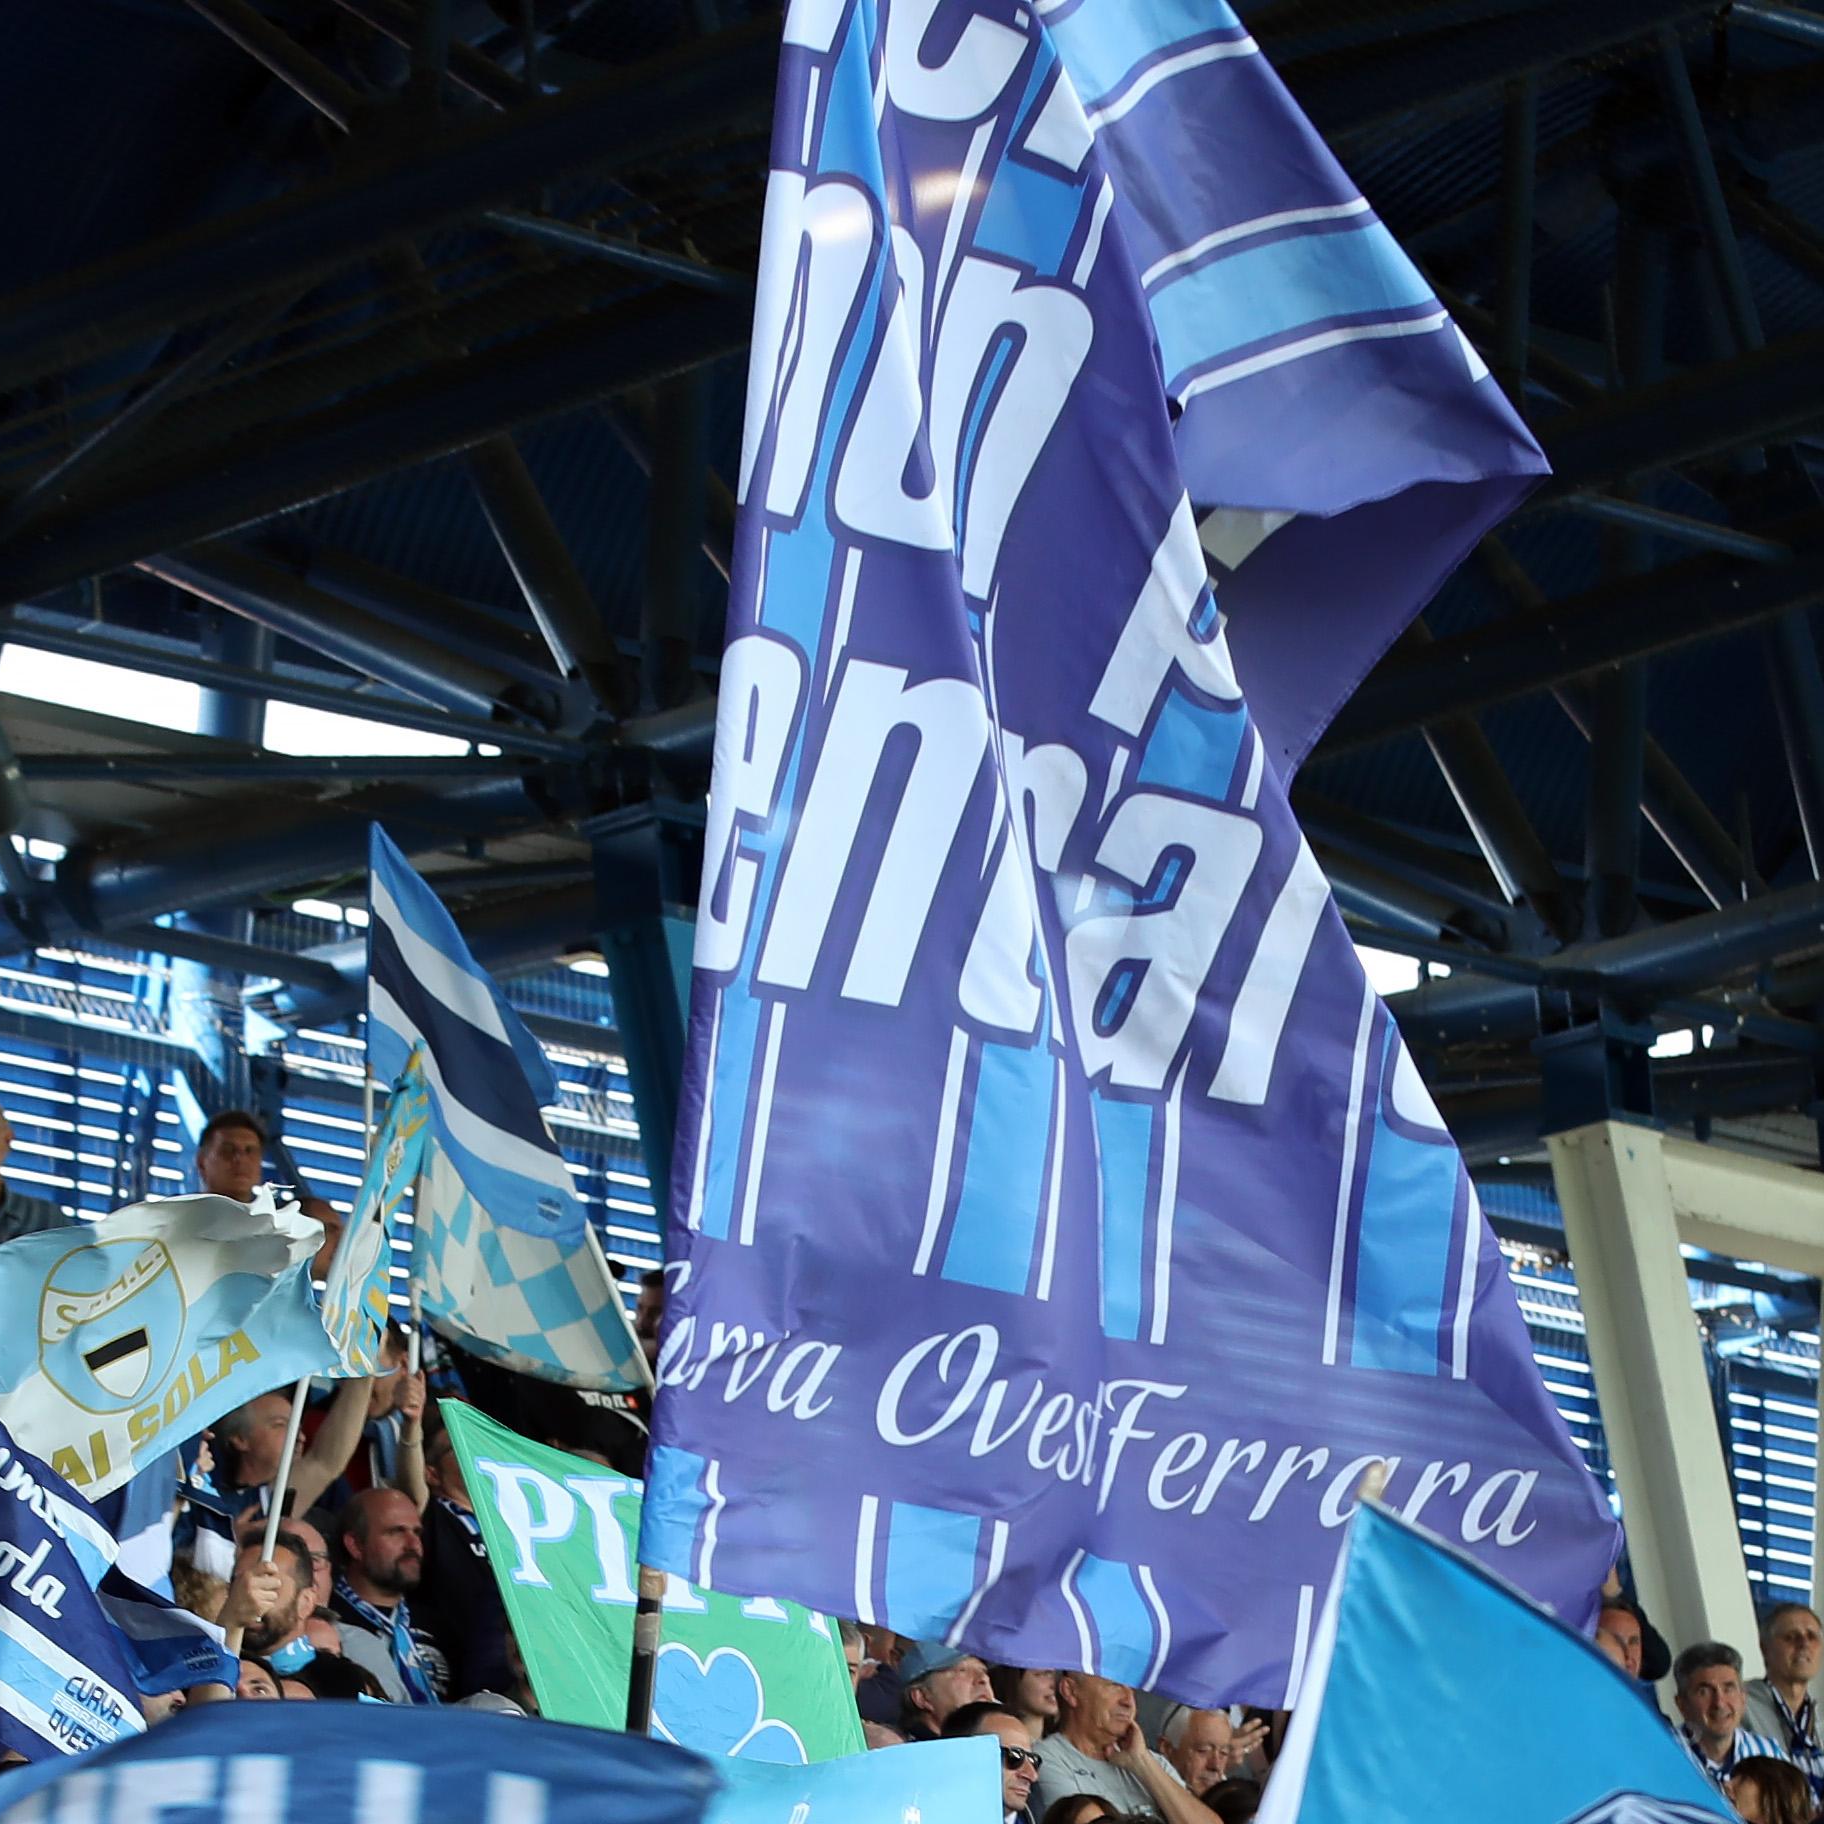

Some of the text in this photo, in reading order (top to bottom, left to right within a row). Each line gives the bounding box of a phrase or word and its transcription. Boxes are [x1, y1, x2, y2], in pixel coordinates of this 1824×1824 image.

[50, 1327, 263, 1487] AI SOLA
[1094, 1378, 1542, 1548] Ferrara
[63, 1676, 124, 1729] CURVA
